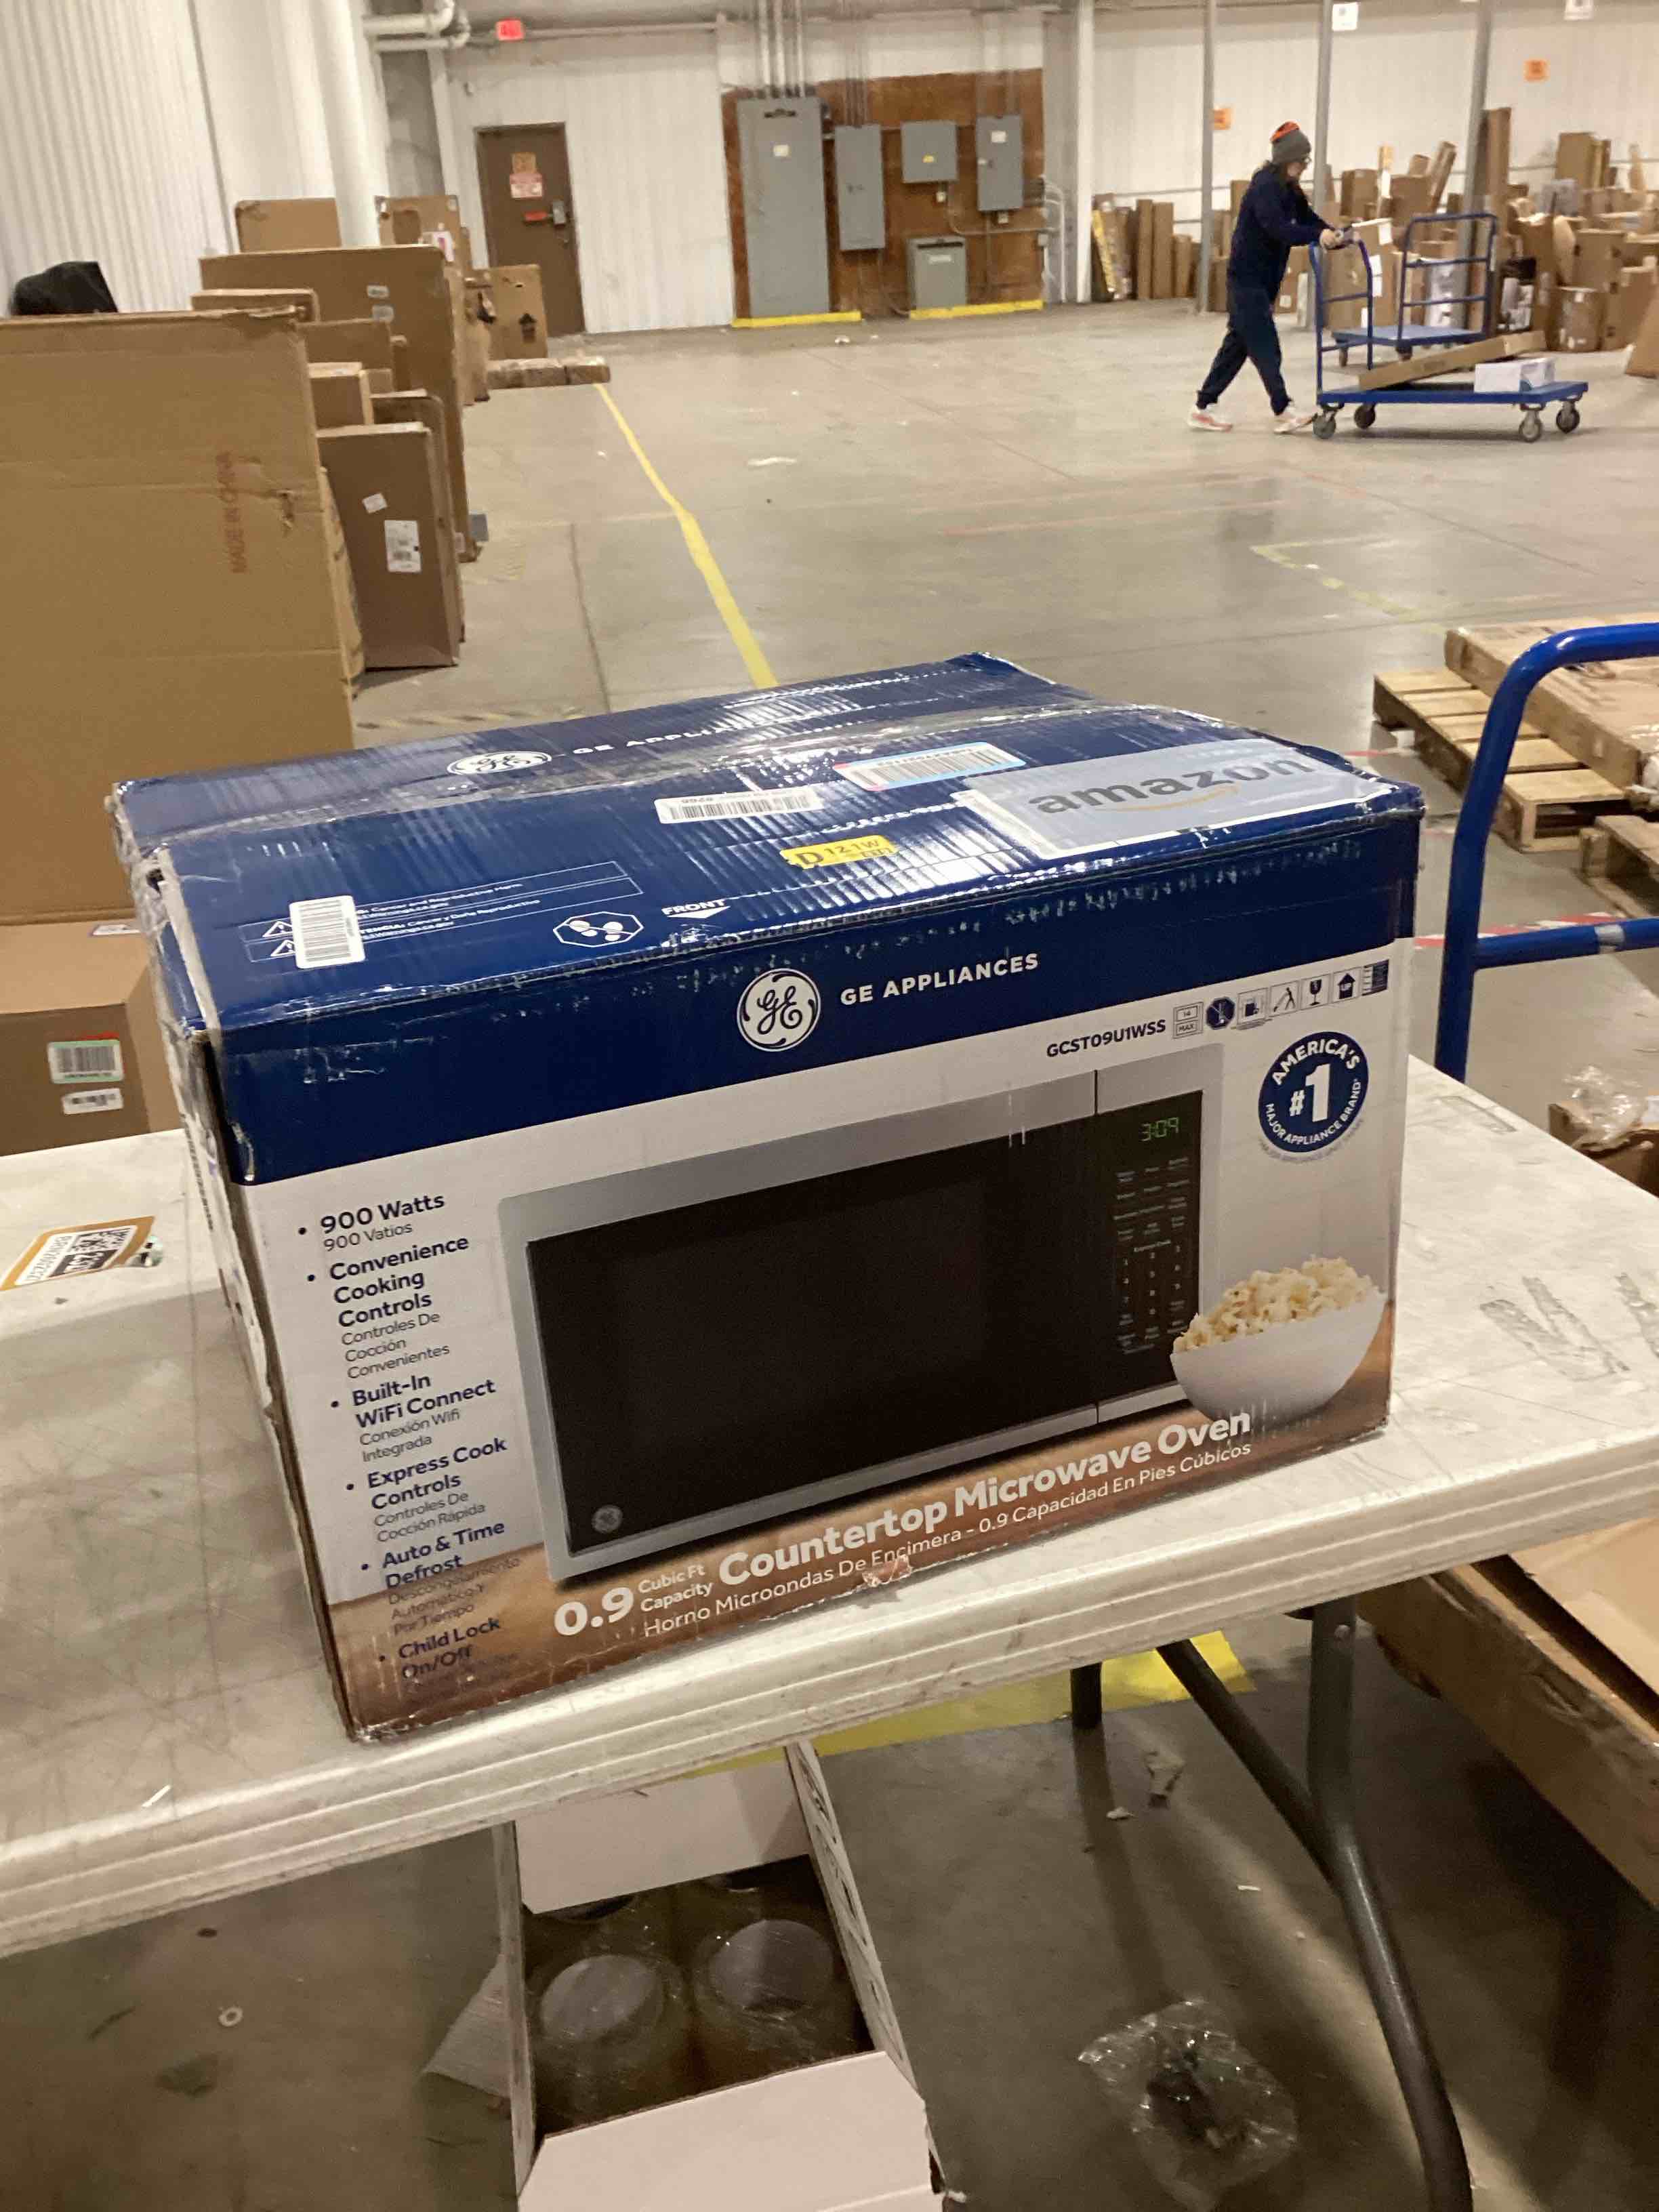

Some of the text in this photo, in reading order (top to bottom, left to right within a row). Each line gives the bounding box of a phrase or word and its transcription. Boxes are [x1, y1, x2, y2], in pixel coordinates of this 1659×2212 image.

[573, 744, 615, 754] GE
[1029, 756, 1315, 815] amazon
[796, 851, 824, 865] D
[661, 899, 727, 916] FRONT
[840, 953, 1039, 1006] GE APPLIANCES
[1046, 1019, 1166, 1057] GCST09U1WSS
[1271, 1038, 1361, 1086] AMERICA'S
[1289, 1063, 1331, 1123] #1
[1139, 1117, 1179, 1143] 3:09
[1265, 1103, 1288, 1139] MAJOR
[1284, 1120, 1343, 1145] APPLIANCE
[1340, 1080, 1361, 1122] BRAND
[320, 1193, 445, 1234] 900 Watts
[323, 1223, 413, 1252] 900 Vatios
[329, 1237, 470, 1280] Convenience
[333, 1271, 426, 1304] Cooking
[338, 1292, 432, 1327] Controls
[342, 1313, 441, 1345] Controles De
[347, 1345, 450, 1378] Convenientes
[352, 1374, 432, 1406] Built-In
[356, 1379, 497, 1428] WiFi Connect
[431, 1408, 461, 1426] Wifi
[363, 1434, 433, 1462] Integrada
[367, 1437, 508, 1490] Express Cook
[371, 1474, 462, 1509] Controls
[718, 1411, 1251, 1586] Countertop Microwave Oven
[374, 1492, 470, 1527] Controles De
[382, 1522, 505, 1569] Auto & Time
[644, 1604, 711, 1638] Horno
[716, 1568, 834, 1615] Microondas
[838, 1558, 868, 1578] De
[871, 1528, 962, 1568] Encimera
[979, 1512, 1008, 1533] 0.9
[1012, 1481, 1108, 1523] Capacidad
[1113, 1475, 1136, 1494] En
[1139, 1465, 1176, 1486] Pies
[385, 1555, 464, 1590] Defrost
[638, 1564, 708, 1595] Cubic Ft
[553, 1586, 634, 1637] 0.9
[640, 1582, 713, 1612] Capacity
[398, 1617, 501, 1659] Child Lock
[402, 1643, 473, 1679] On/Off
